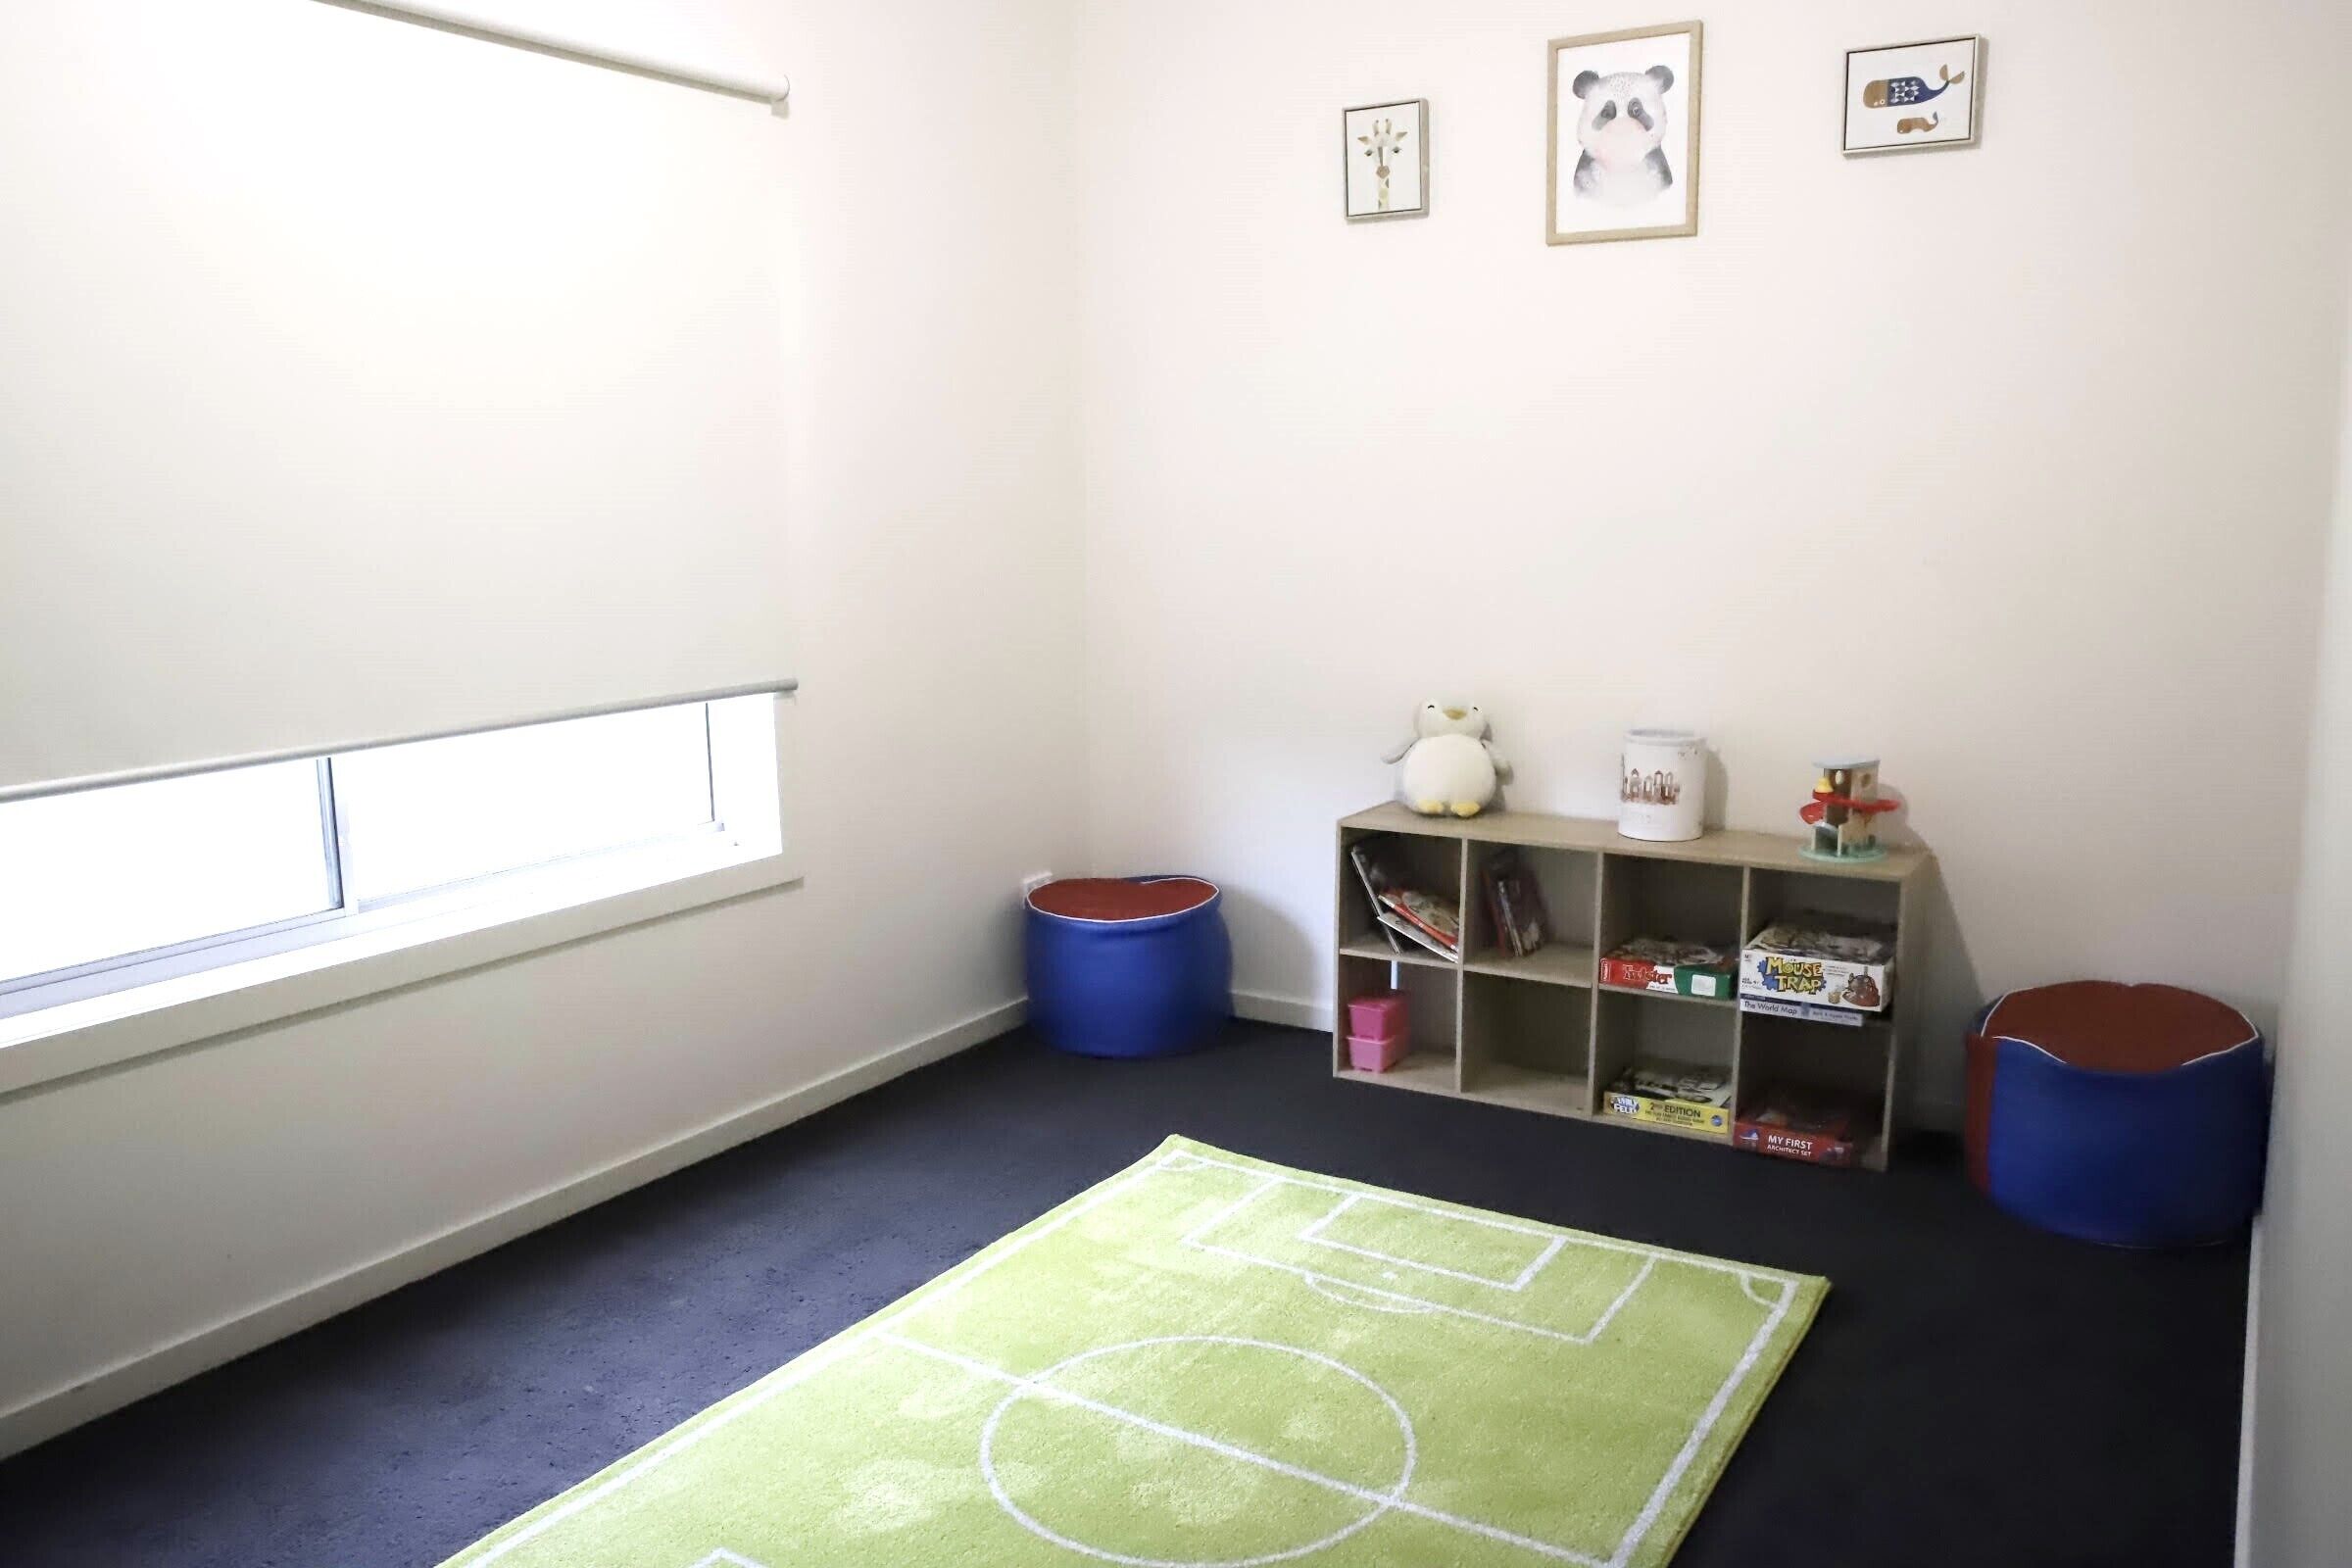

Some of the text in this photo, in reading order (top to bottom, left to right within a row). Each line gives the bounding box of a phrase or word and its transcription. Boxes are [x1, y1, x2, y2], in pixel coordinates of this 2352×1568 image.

[1765, 956, 1823, 977] MOUSE
[1775, 975, 1822, 995] TRAP
[1744, 1001, 1797, 1016] The World Map
[1664, 1104, 1701, 1118] EDITION
[1767, 1145, 1799, 1154] ARCHITECT
[1768, 1135, 1813, 1150] MY FIRST
